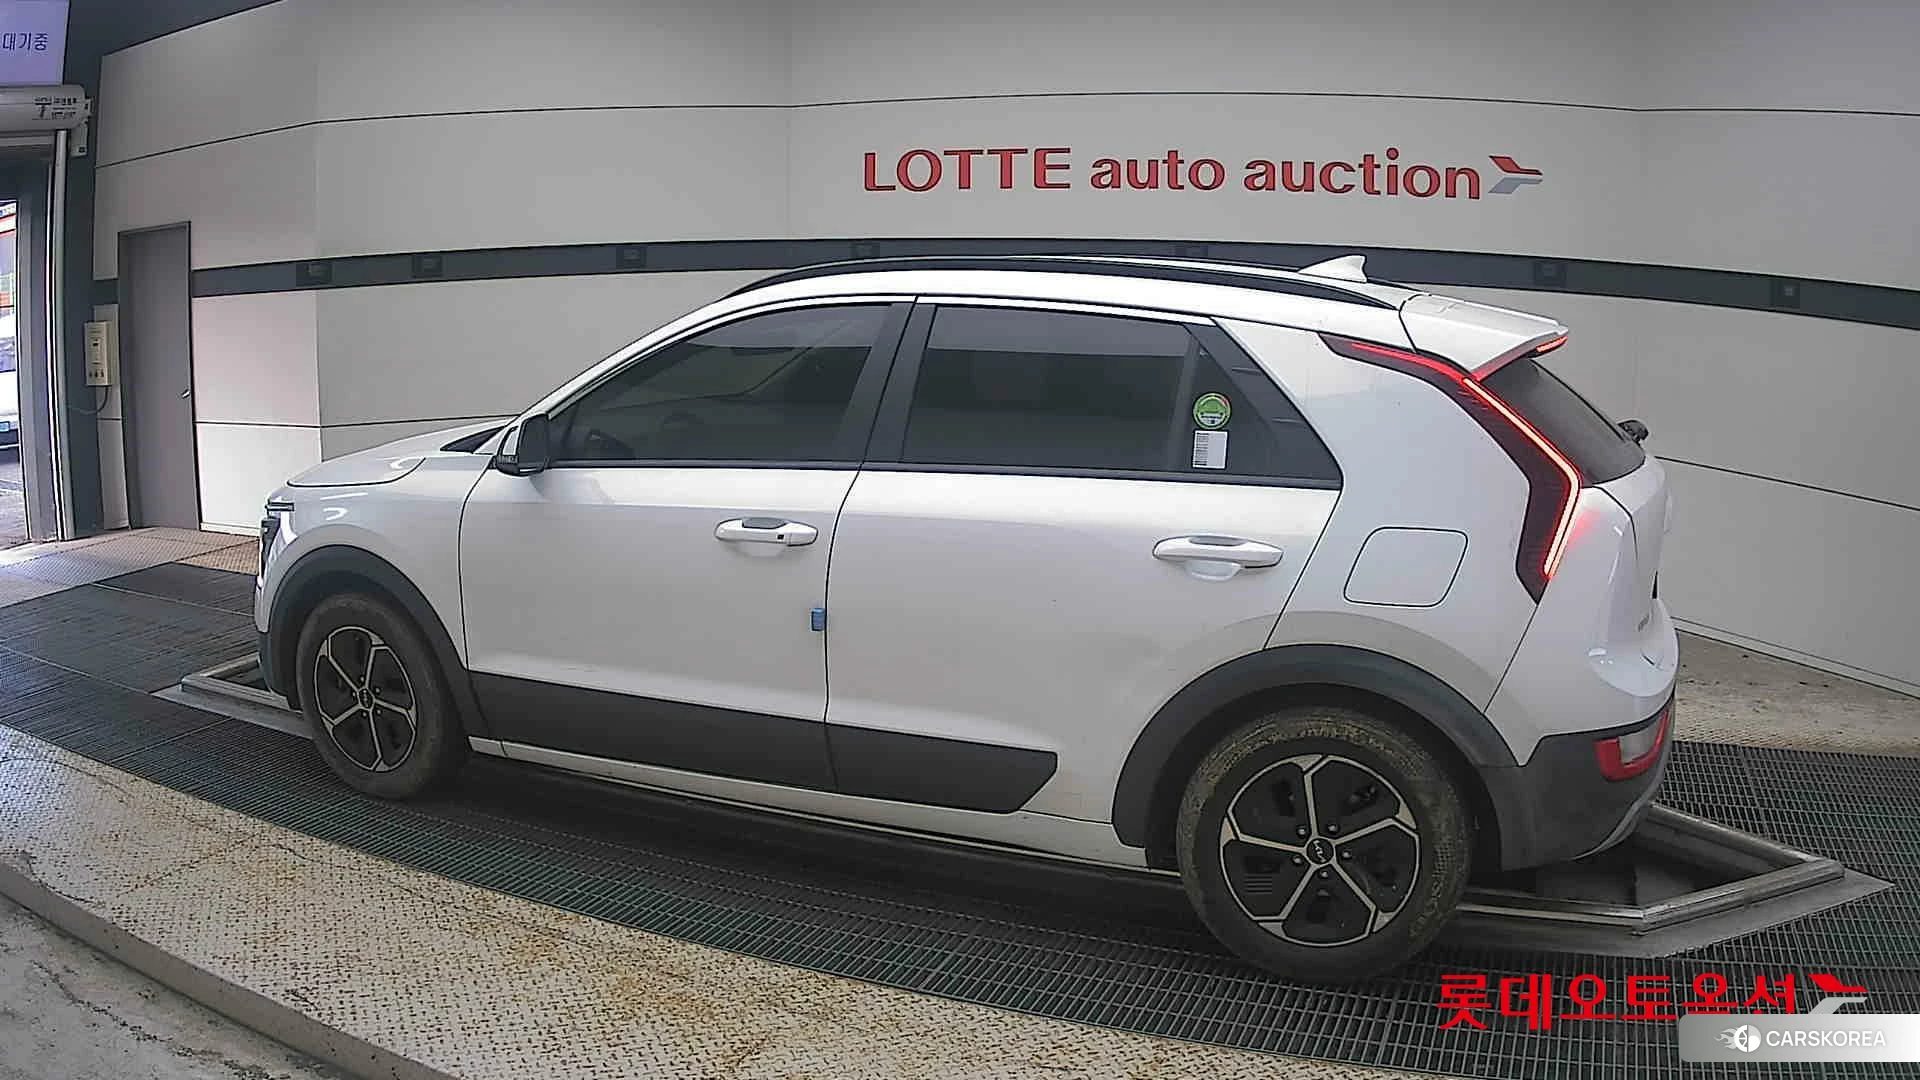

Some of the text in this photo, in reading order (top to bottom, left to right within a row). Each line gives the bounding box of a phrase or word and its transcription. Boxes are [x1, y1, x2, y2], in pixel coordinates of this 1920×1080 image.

[863, 147, 1481, 200] LOTTE auto auction
